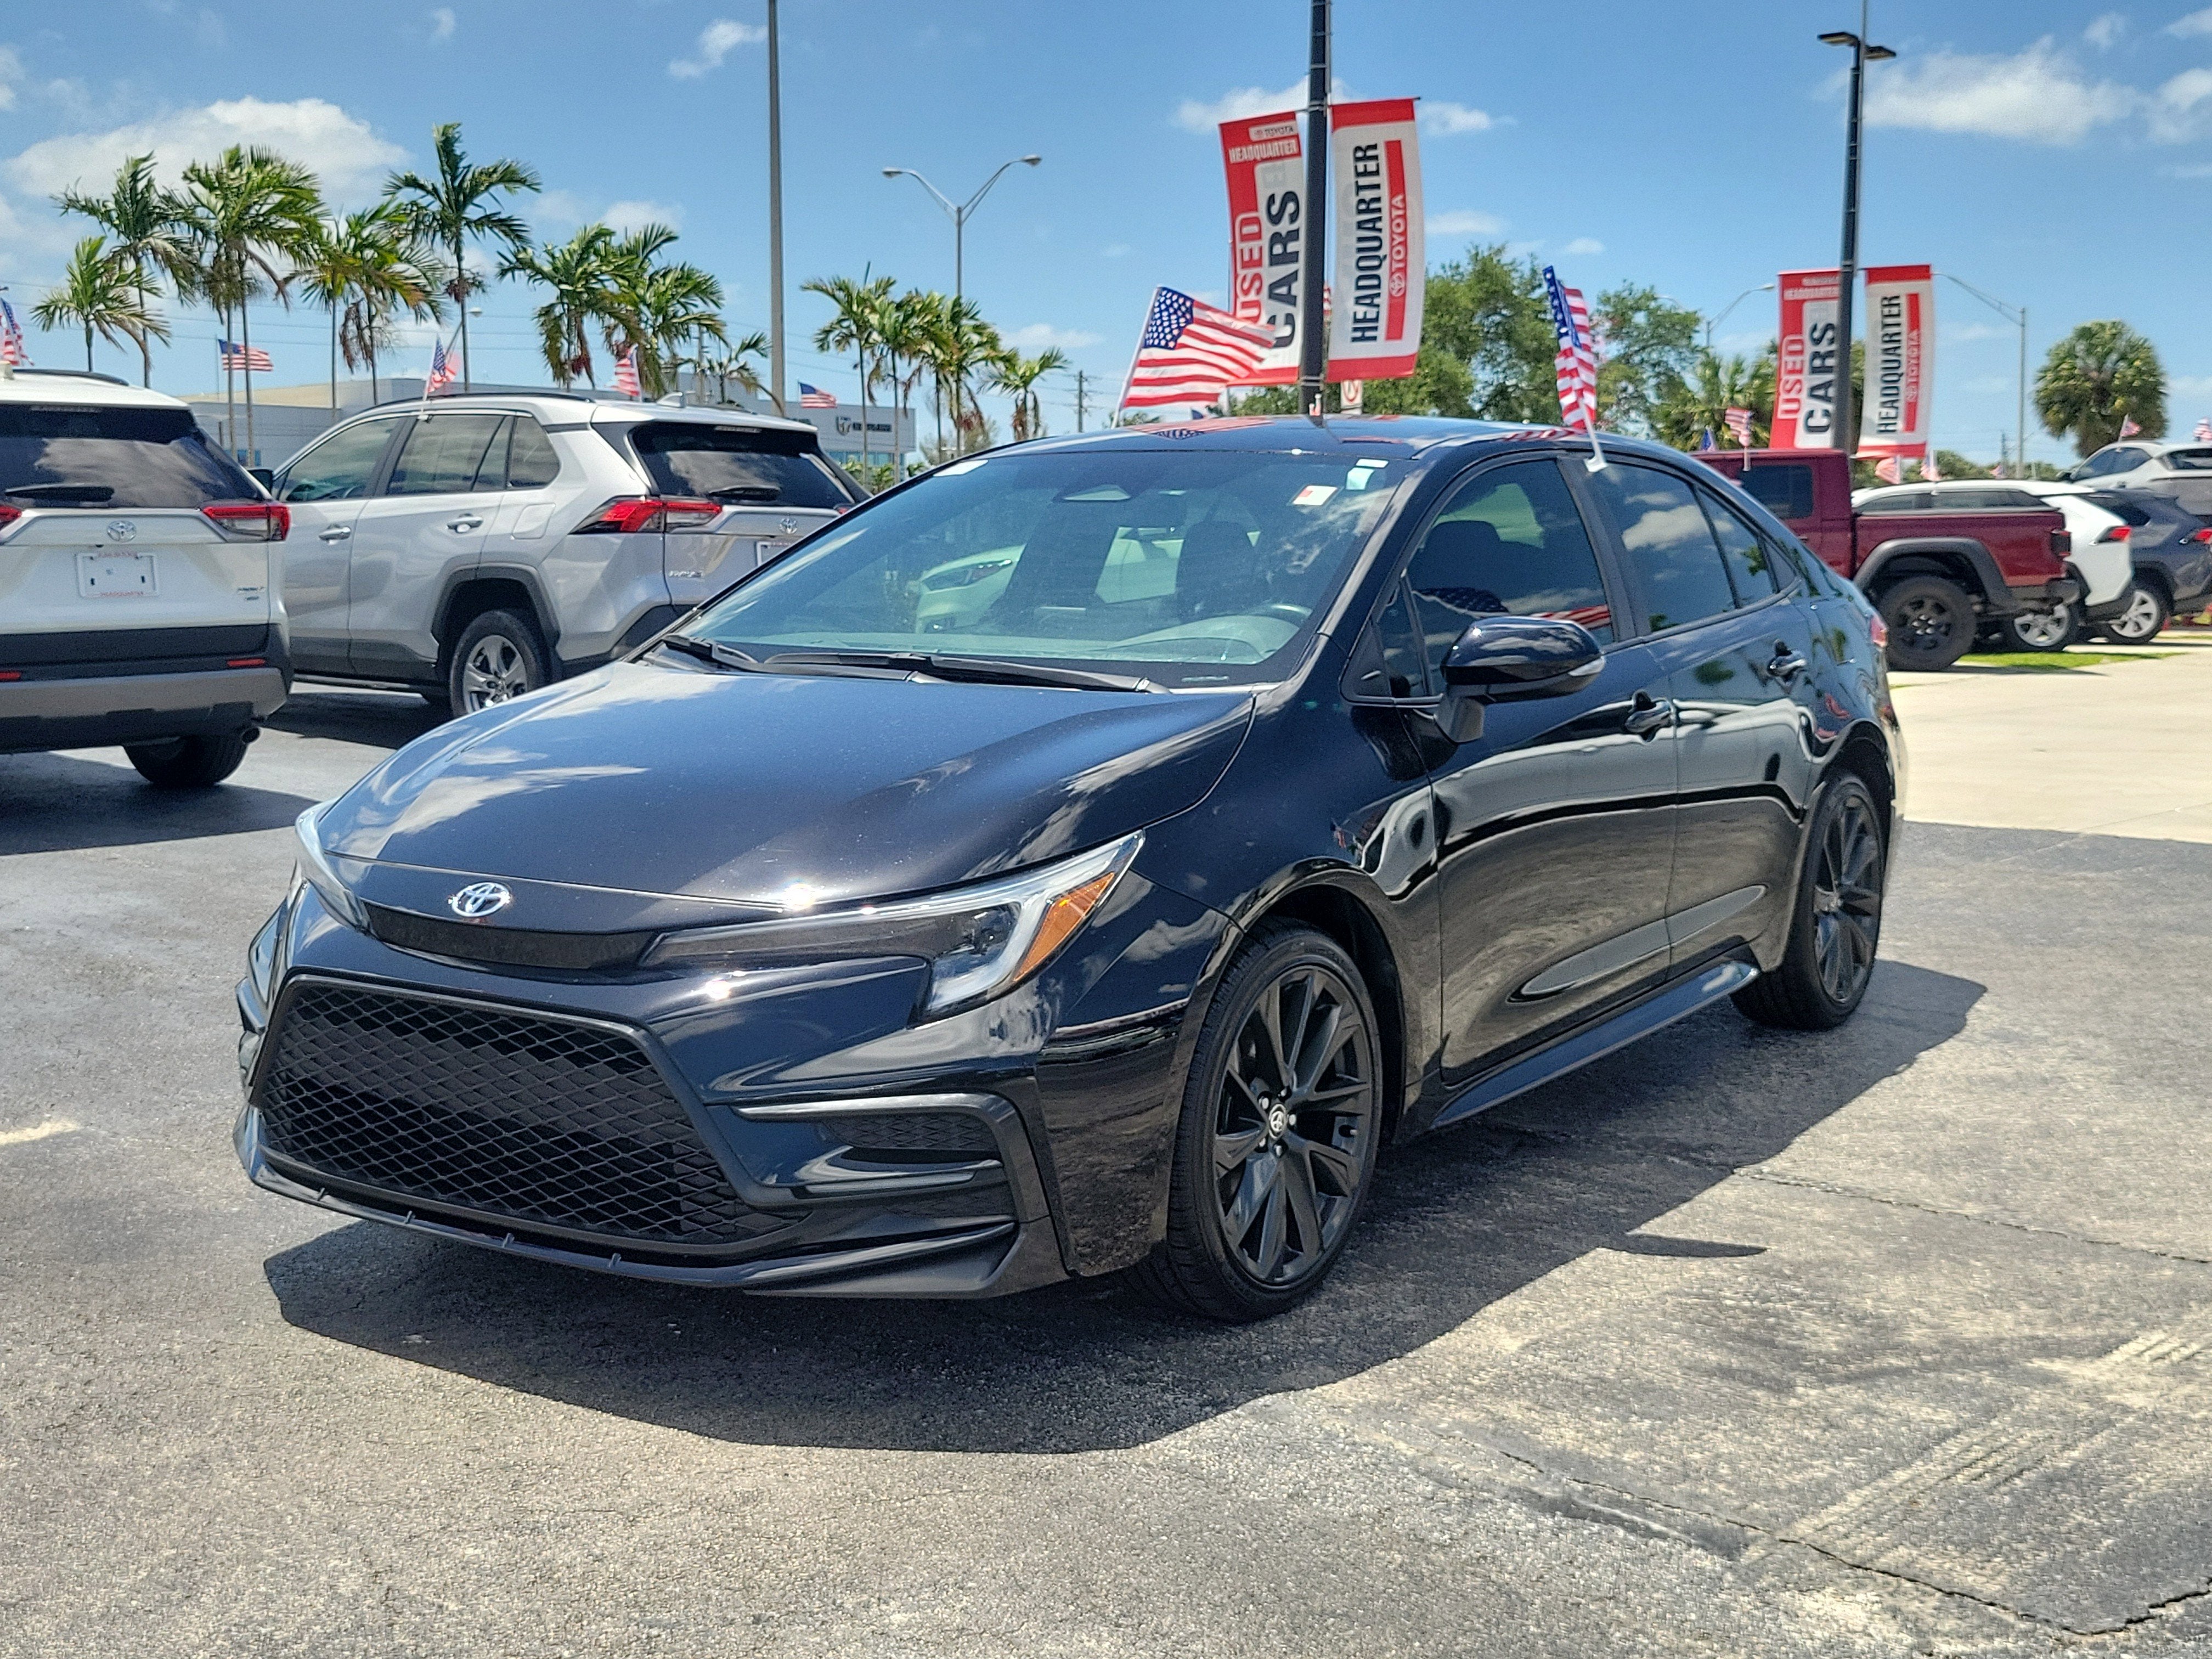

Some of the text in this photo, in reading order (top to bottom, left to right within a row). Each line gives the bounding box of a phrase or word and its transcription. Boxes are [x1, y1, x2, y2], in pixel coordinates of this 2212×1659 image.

[1229, 139, 1297, 163] HEADQUARTER
[1264, 126, 1294, 137] TOYOTA
[1237, 214, 1262, 324] USED
[1266, 191, 1300, 348] CARS
[1351, 143, 1387, 342] HEADQUARTER
[1391, 195, 1407, 270] TOYOTA
[1780, 335, 1804, 417] USED
[1804, 322, 1837, 433] CARS
[1876, 295, 1903, 434] HEADQUARTER
